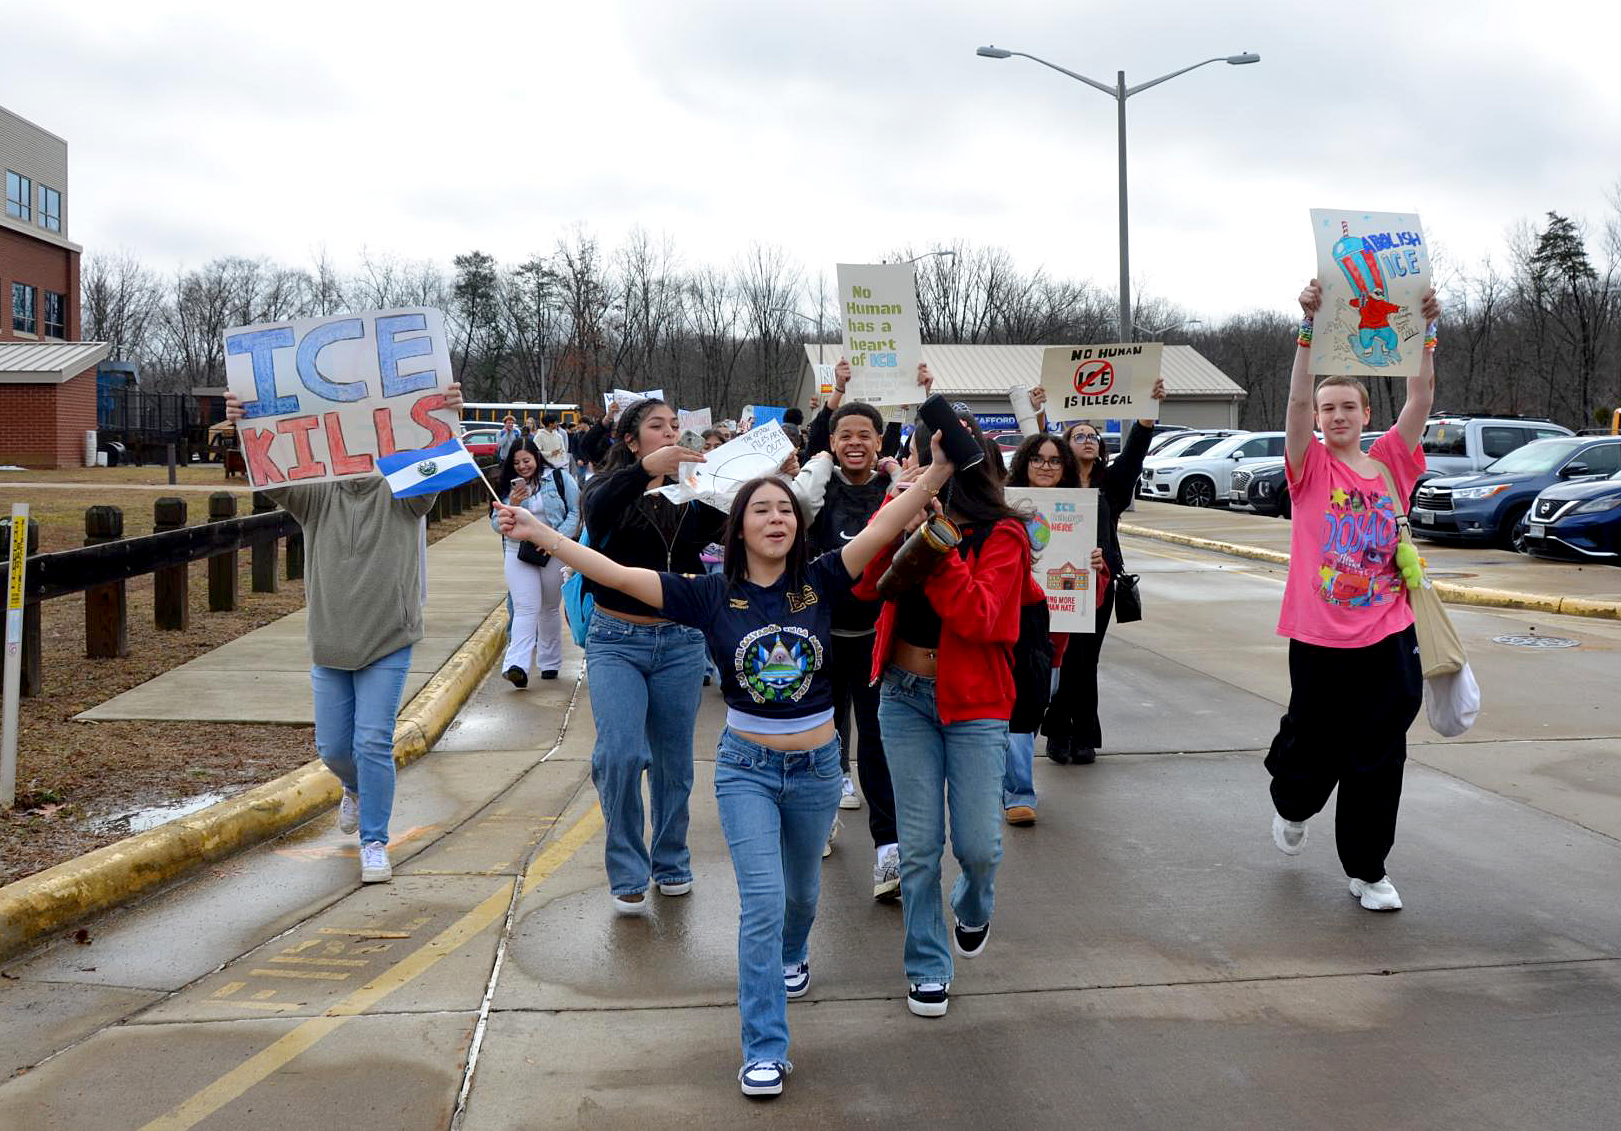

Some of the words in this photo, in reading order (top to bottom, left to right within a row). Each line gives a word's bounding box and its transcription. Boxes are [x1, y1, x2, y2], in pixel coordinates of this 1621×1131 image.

[1361, 231, 1421, 254] ABOLISH
[1381, 249, 1420, 279] ICE
[852, 285, 871, 299] No
[847, 302, 902, 315] Human
[848, 318, 875, 332] has
[881, 322, 892, 332] a
[850, 337, 896, 351] heart
[851, 353, 866, 367] of
[1071, 348, 1093, 361] NO
[1098, 346, 1142, 359] HUMAN
[226, 313, 438, 419] ICE
[1077, 371, 1111, 387] ICE
[1064, 396, 1078, 408] IS
[1082, 394, 1132, 407] ILLEGAL
[975, 416, 1015, 424] AFFORD
[241, 394, 454, 487] KILLS
[1051, 523, 1074, 533] HERE
[786, 584, 818, 614] ES
[1058, 596, 1076, 605] MORE
[1060, 604, 1076, 613] HATE
